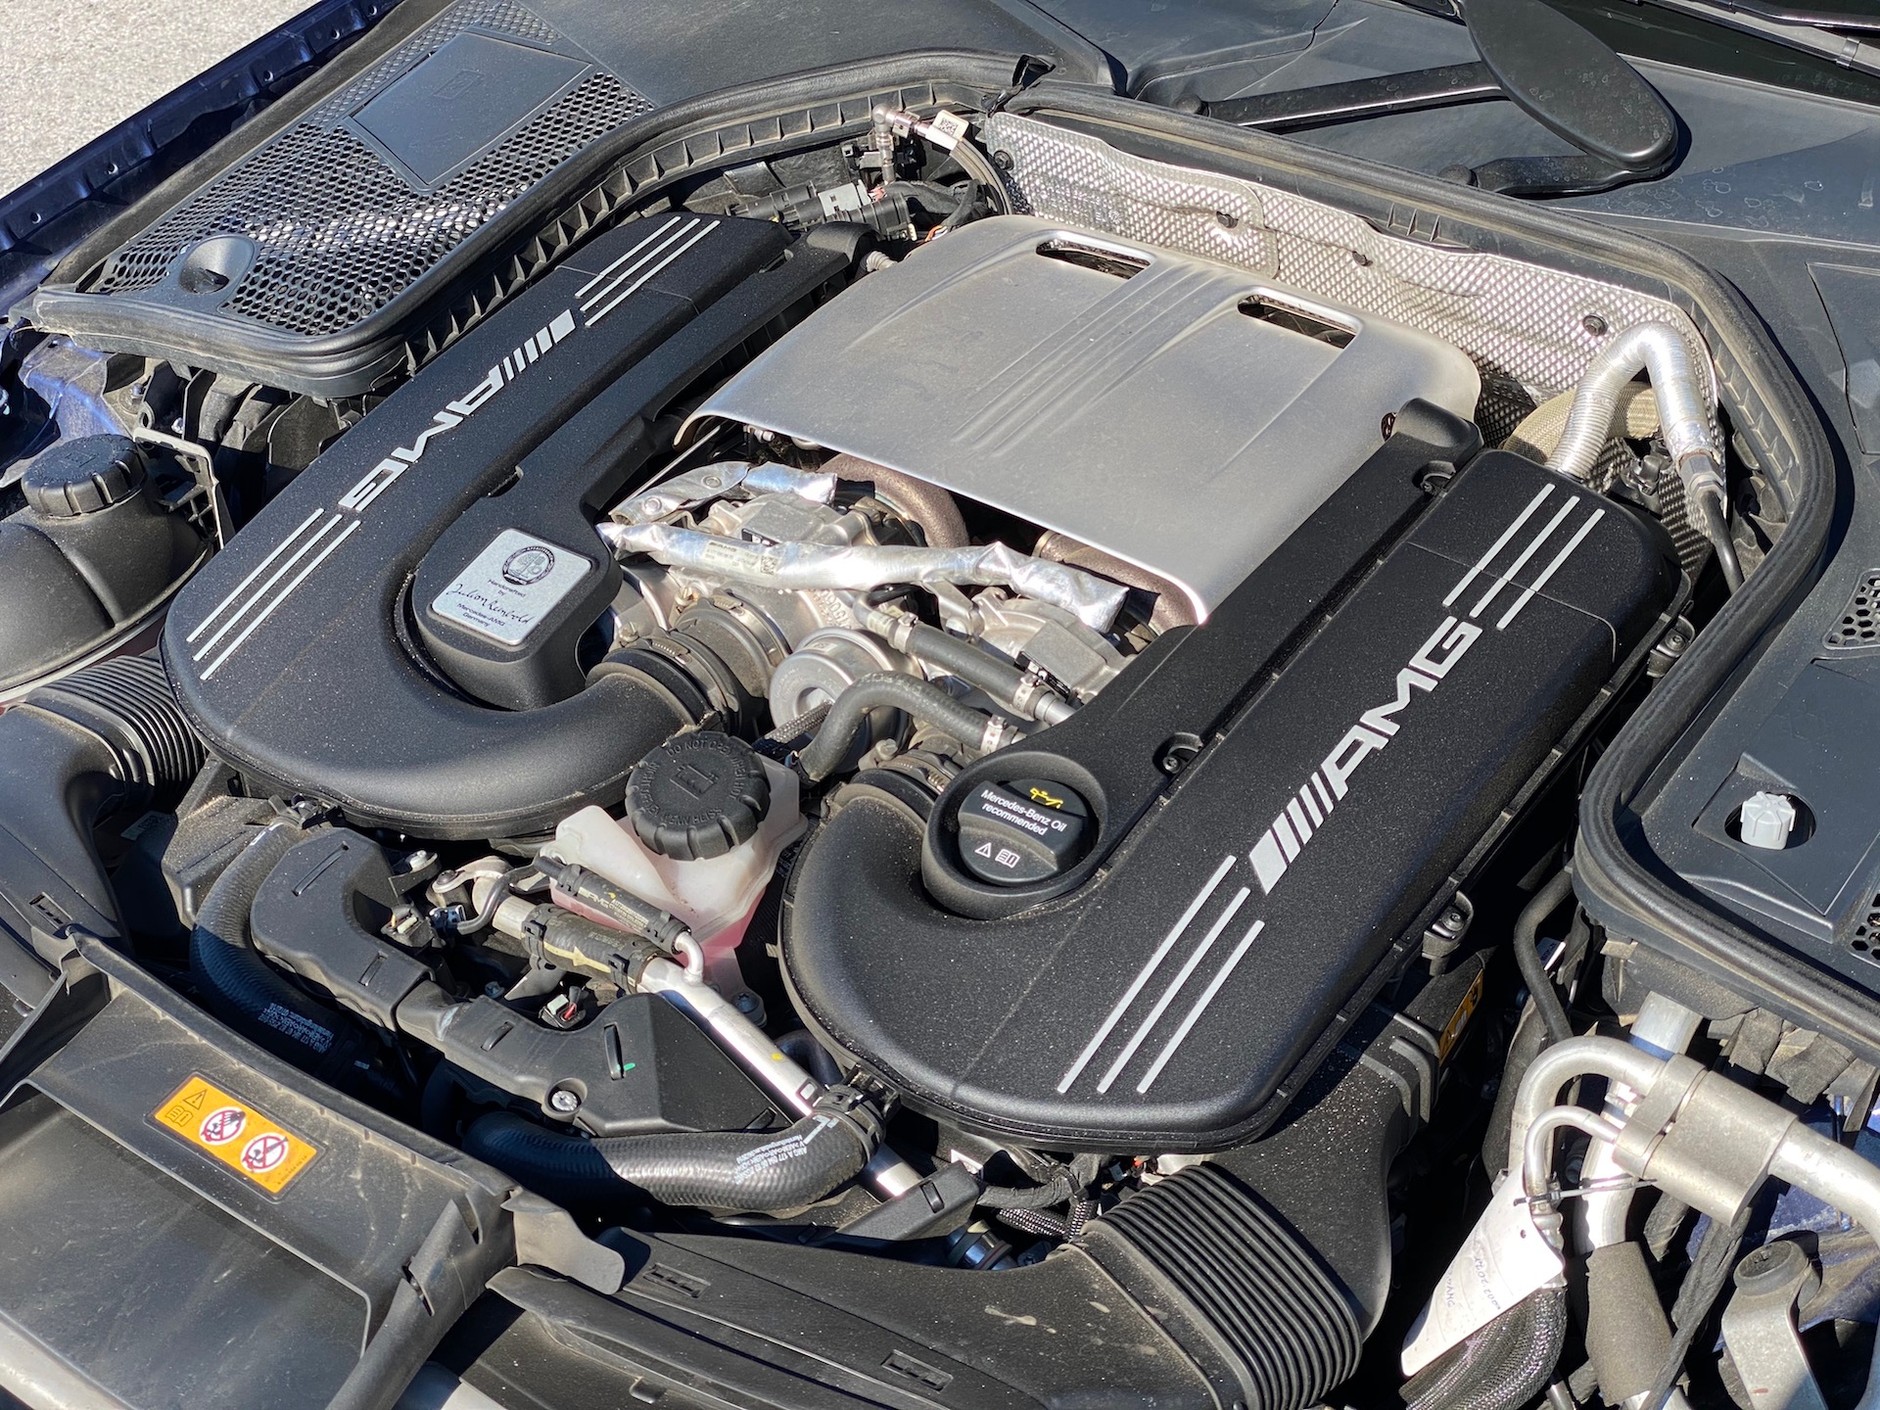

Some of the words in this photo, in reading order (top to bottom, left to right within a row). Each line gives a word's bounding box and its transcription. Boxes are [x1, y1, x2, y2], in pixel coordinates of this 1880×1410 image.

[457, 603, 505, 626] Mercedes-AMG
[462, 612, 491, 627] Germany
[684, 739, 707, 750] NOT
[981, 789, 1051, 826] Mercedes-Benz
[1051, 820, 1067, 833] Oil
[982, 803, 1048, 836] recommended
